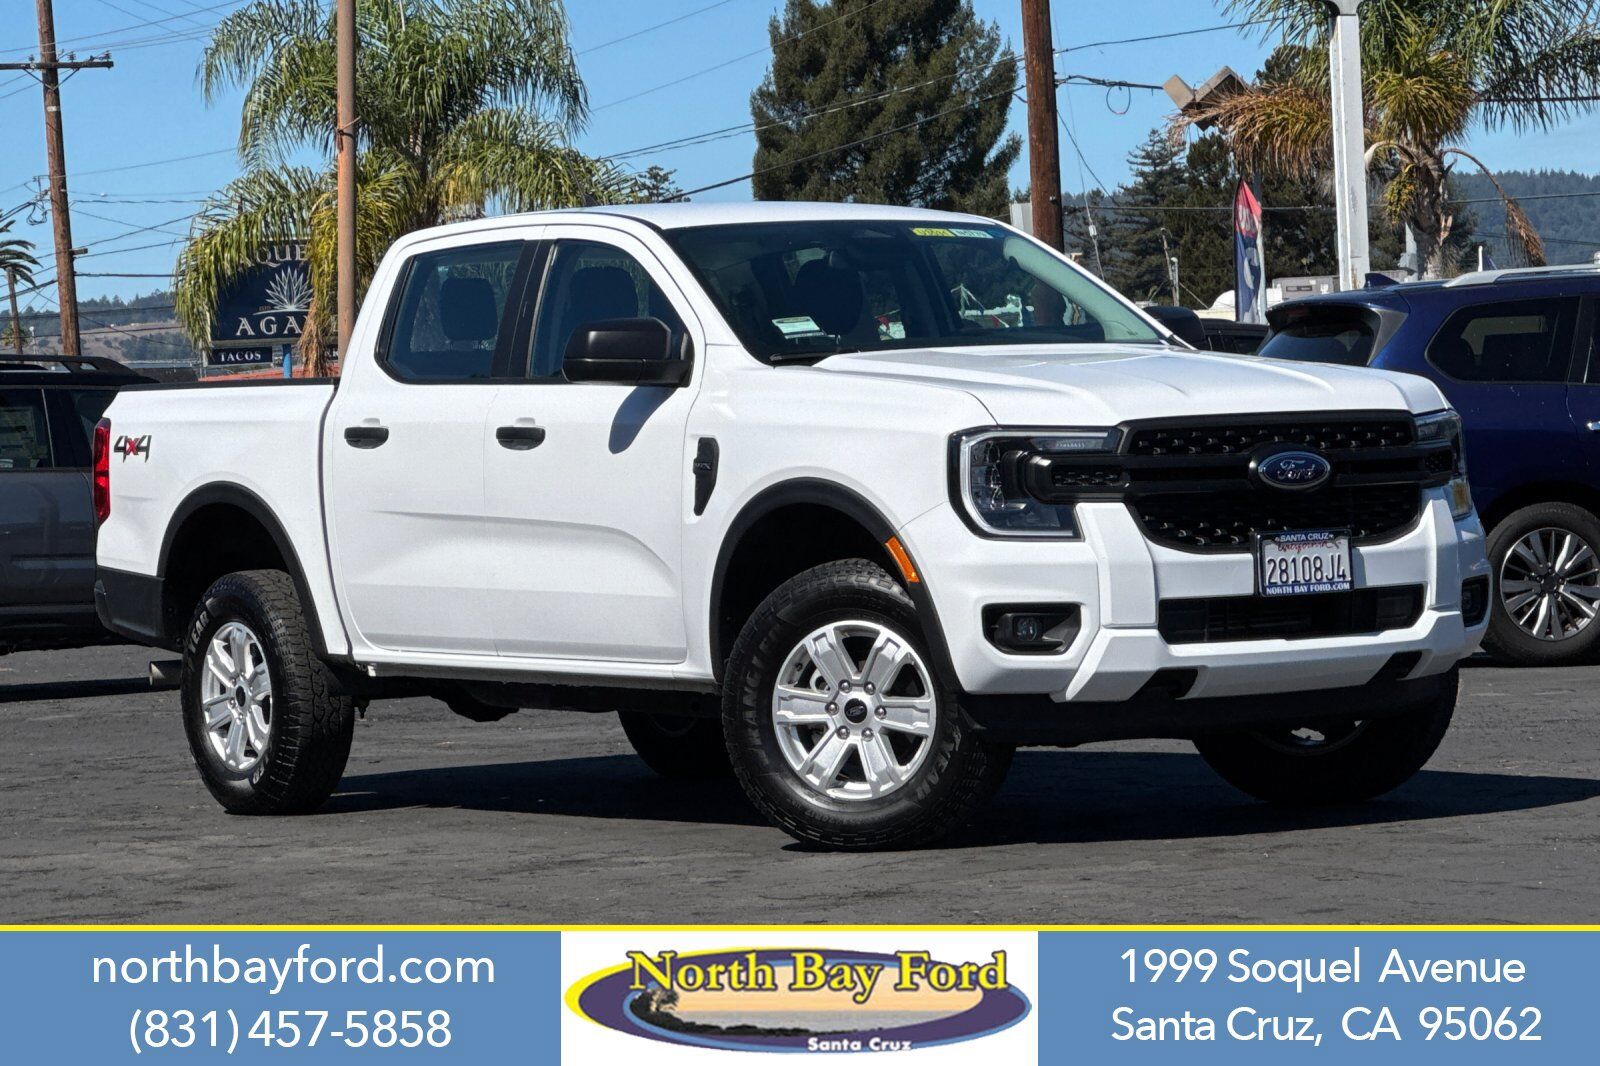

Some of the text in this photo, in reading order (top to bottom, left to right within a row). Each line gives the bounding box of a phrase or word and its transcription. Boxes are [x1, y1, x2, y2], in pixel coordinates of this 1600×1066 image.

[236, 316, 306, 336] AGA
[220, 351, 262, 362] TACOS
[113, 435, 152, 463] 4x4
[1277, 459, 1316, 480] Ford
[1280, 532, 1329, 542] SANTA CRUZ
[1267, 553, 1347, 585] 28108J4
[1266, 582, 1350, 595] NORTH BAY FORD.COM
